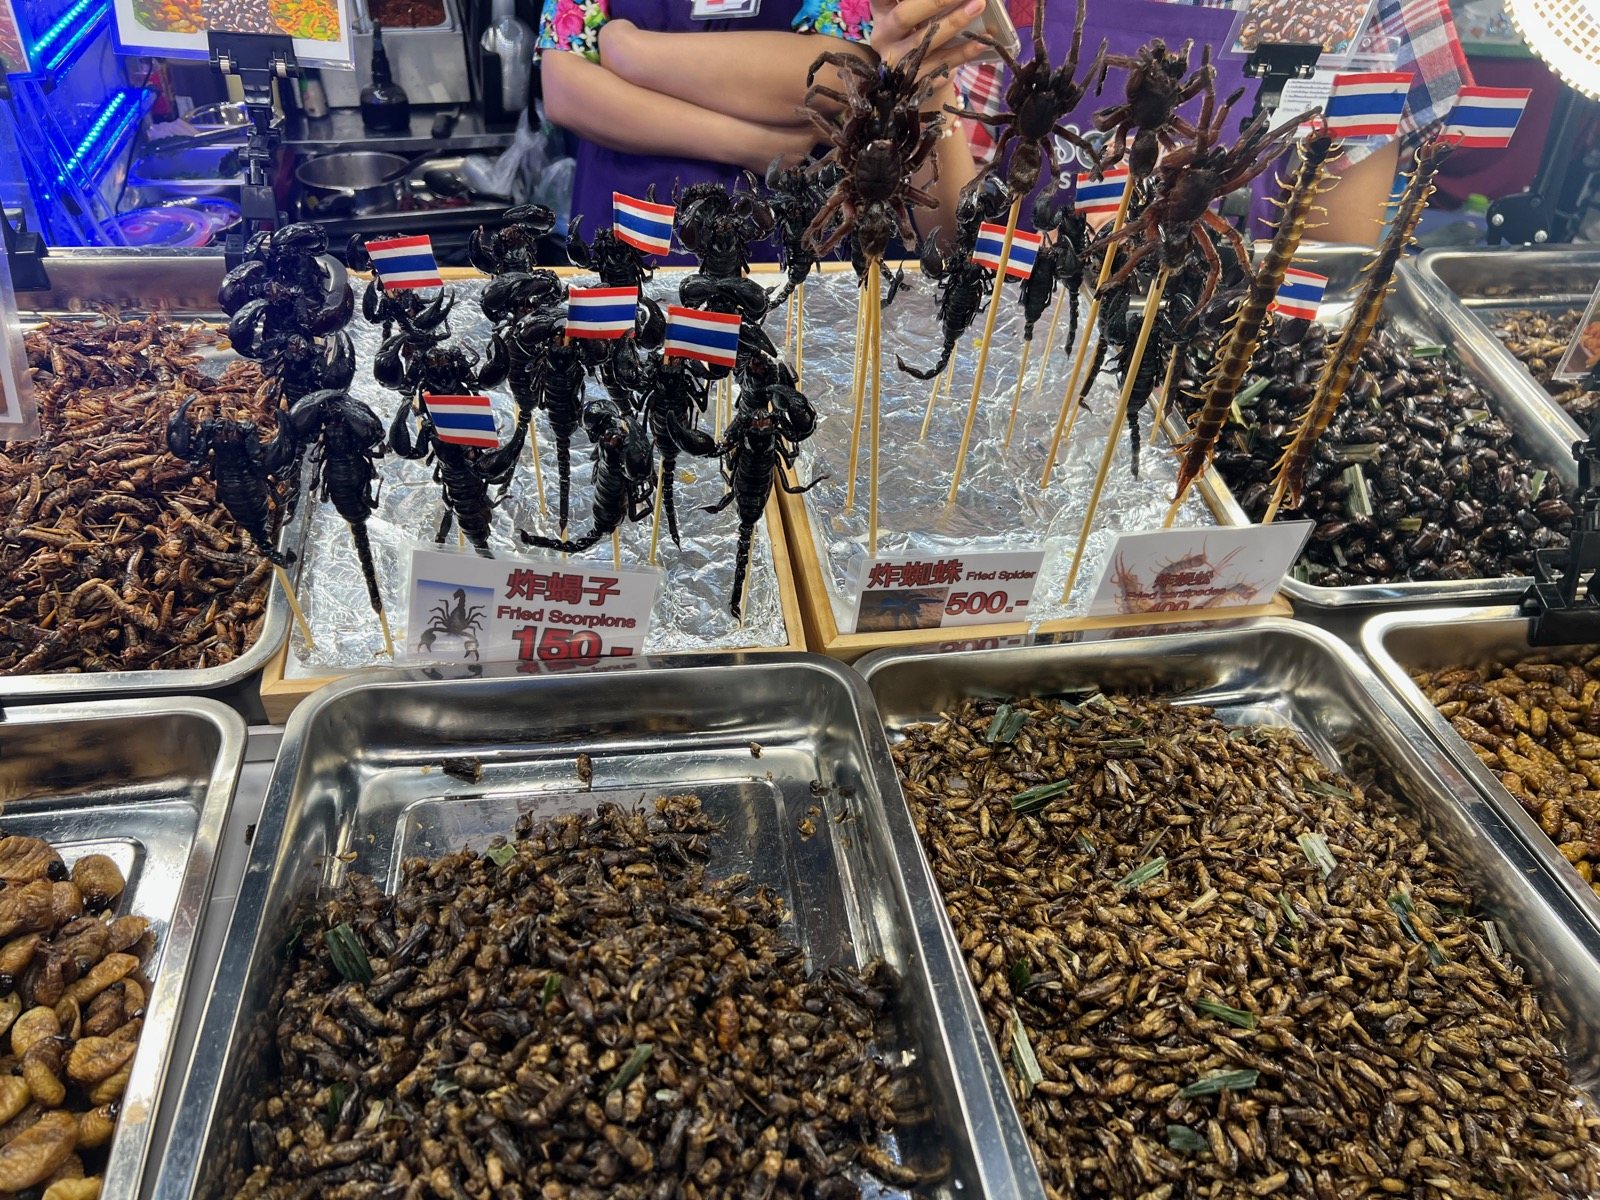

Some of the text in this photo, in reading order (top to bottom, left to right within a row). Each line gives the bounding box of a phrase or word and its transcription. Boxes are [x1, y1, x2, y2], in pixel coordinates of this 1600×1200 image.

[505, 568, 621, 606] 炸蝎子
[867, 558, 964, 588] 炸蜘蛛
[966, 569, 1037, 582] Fried Spider
[497, 605, 637, 629] Fried Scorpions
[945, 590, 1029, 616] 500.-
[512, 625, 634, 660] 150-
